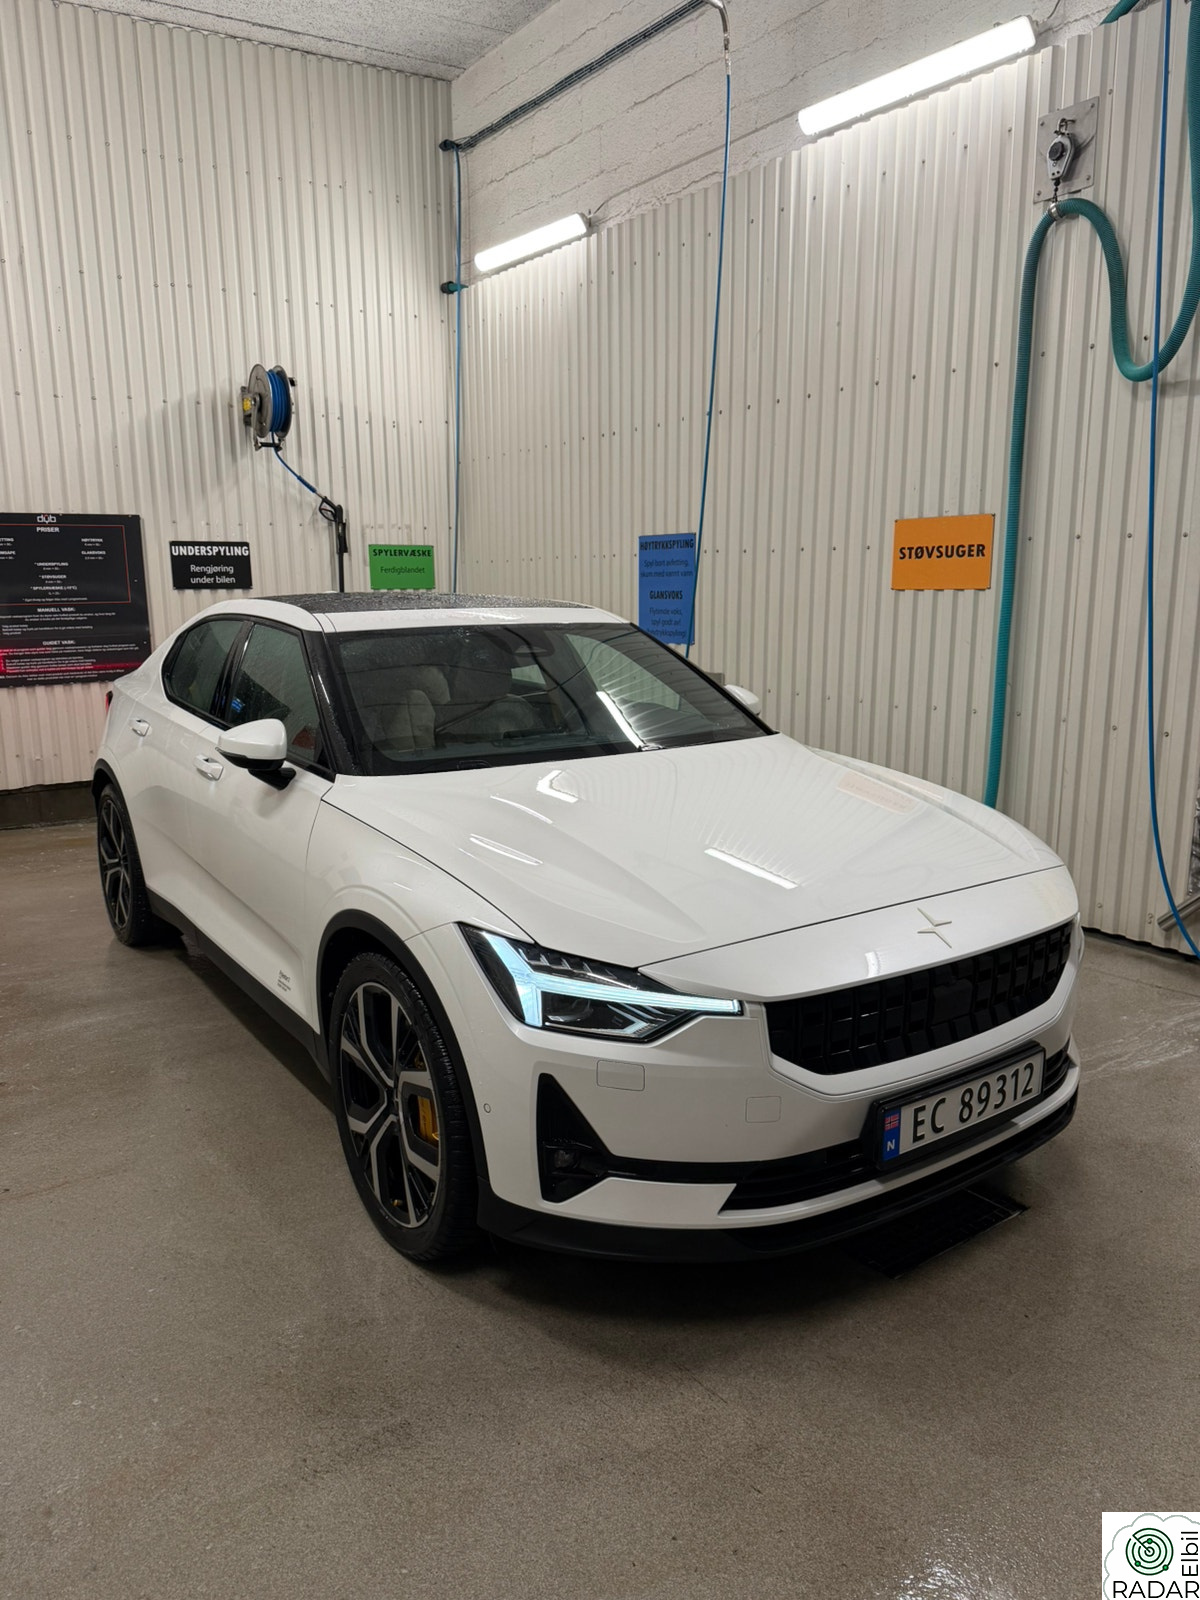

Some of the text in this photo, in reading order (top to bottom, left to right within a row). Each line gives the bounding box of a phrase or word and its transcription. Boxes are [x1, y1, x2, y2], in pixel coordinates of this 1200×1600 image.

[639, 538, 695, 551] HØYTRYKKSPYLING
[171, 545, 250, 557] UNDERSPYLING
[372, 548, 432, 558] SPYLERVÆSKE
[899, 543, 986, 560] STØVSUGER
[190, 564, 234, 575] Rengjøring
[380, 565, 426, 576] Ferdigblandet
[190, 574, 236, 584] under bilen
[649, 590, 683, 600] GLANSVOKS
[912, 1062, 1034, 1143] EC 89312
[886, 1138, 895, 1152] N
